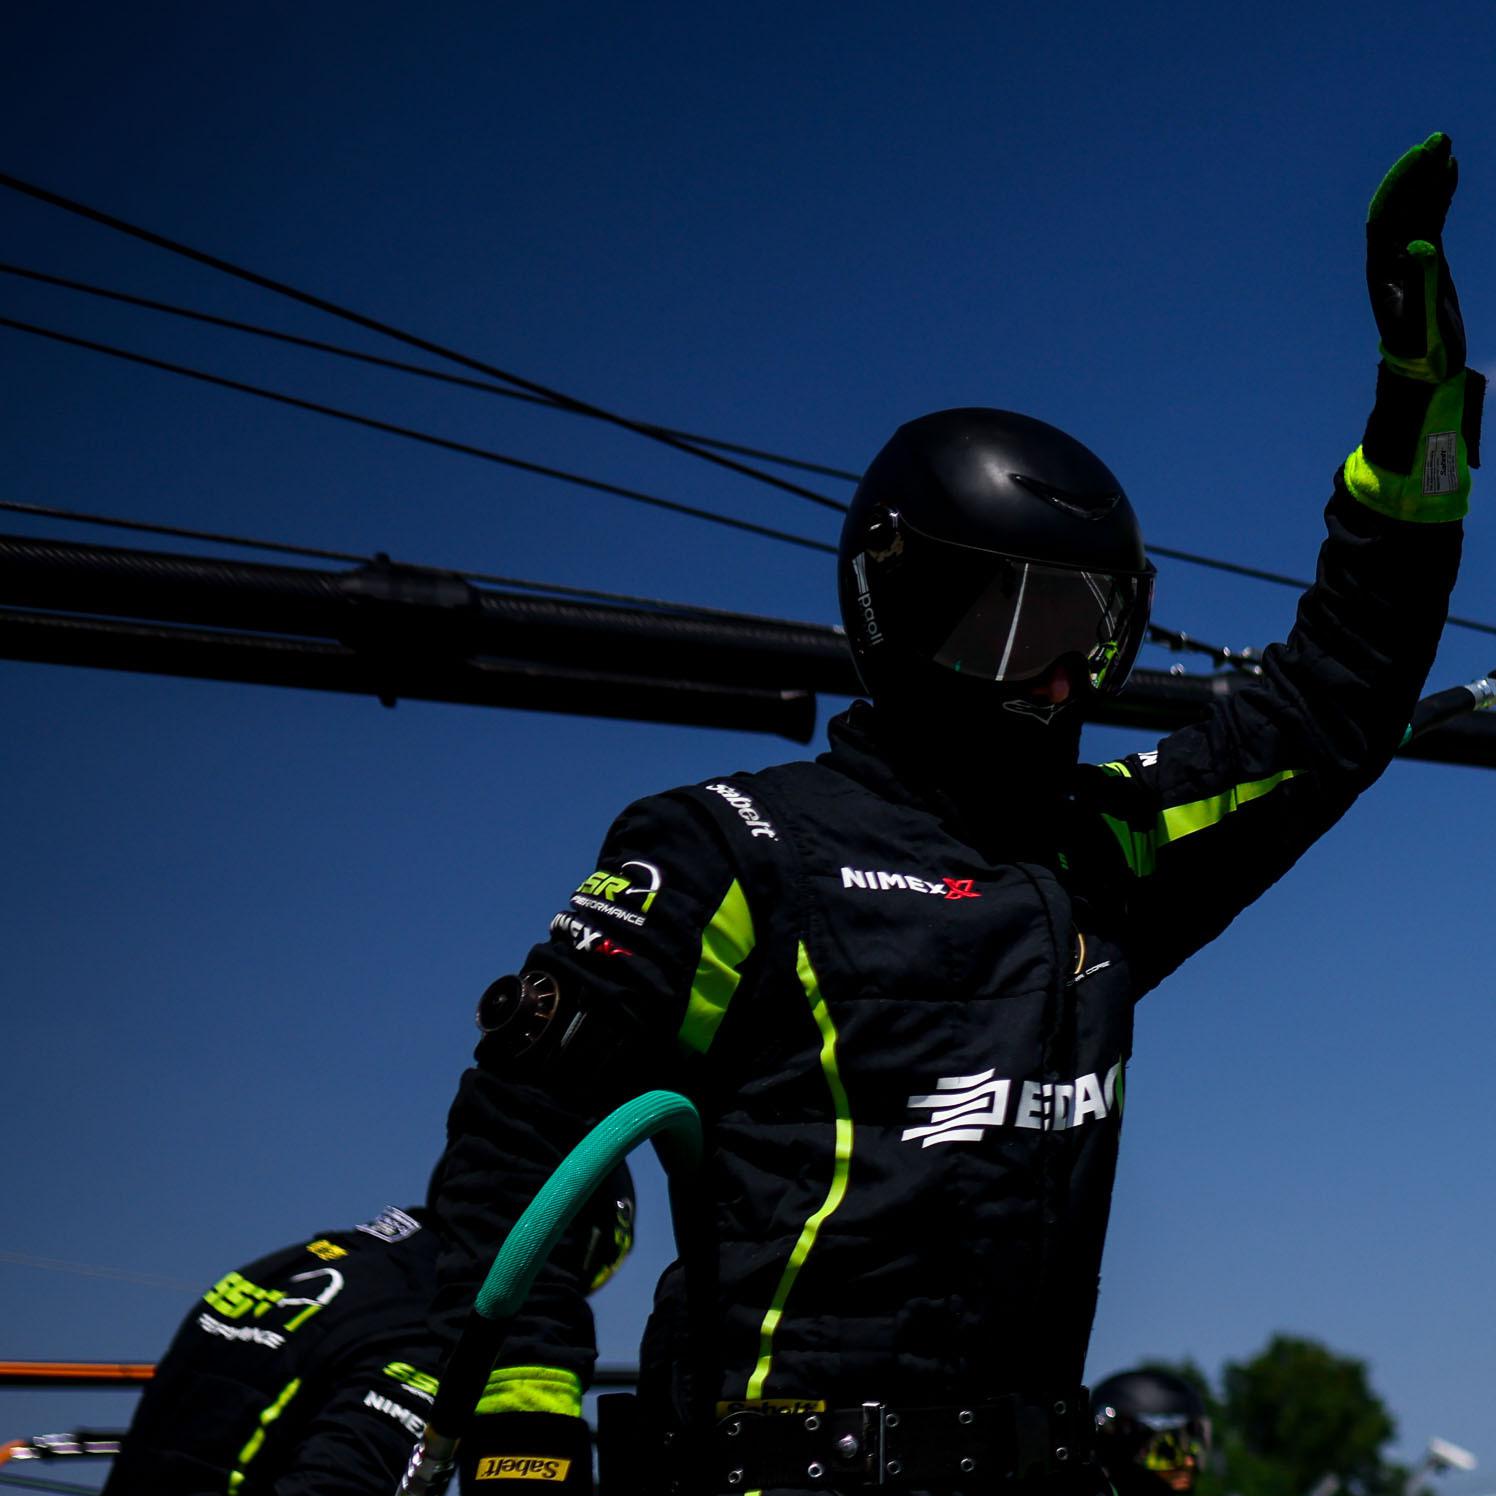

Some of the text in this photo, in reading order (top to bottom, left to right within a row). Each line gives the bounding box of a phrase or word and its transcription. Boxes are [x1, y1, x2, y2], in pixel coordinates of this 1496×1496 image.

[858, 592, 884, 646] paoli
[575, 871, 631, 901] SR
[483, 1459, 560, 1479] Sabelt
